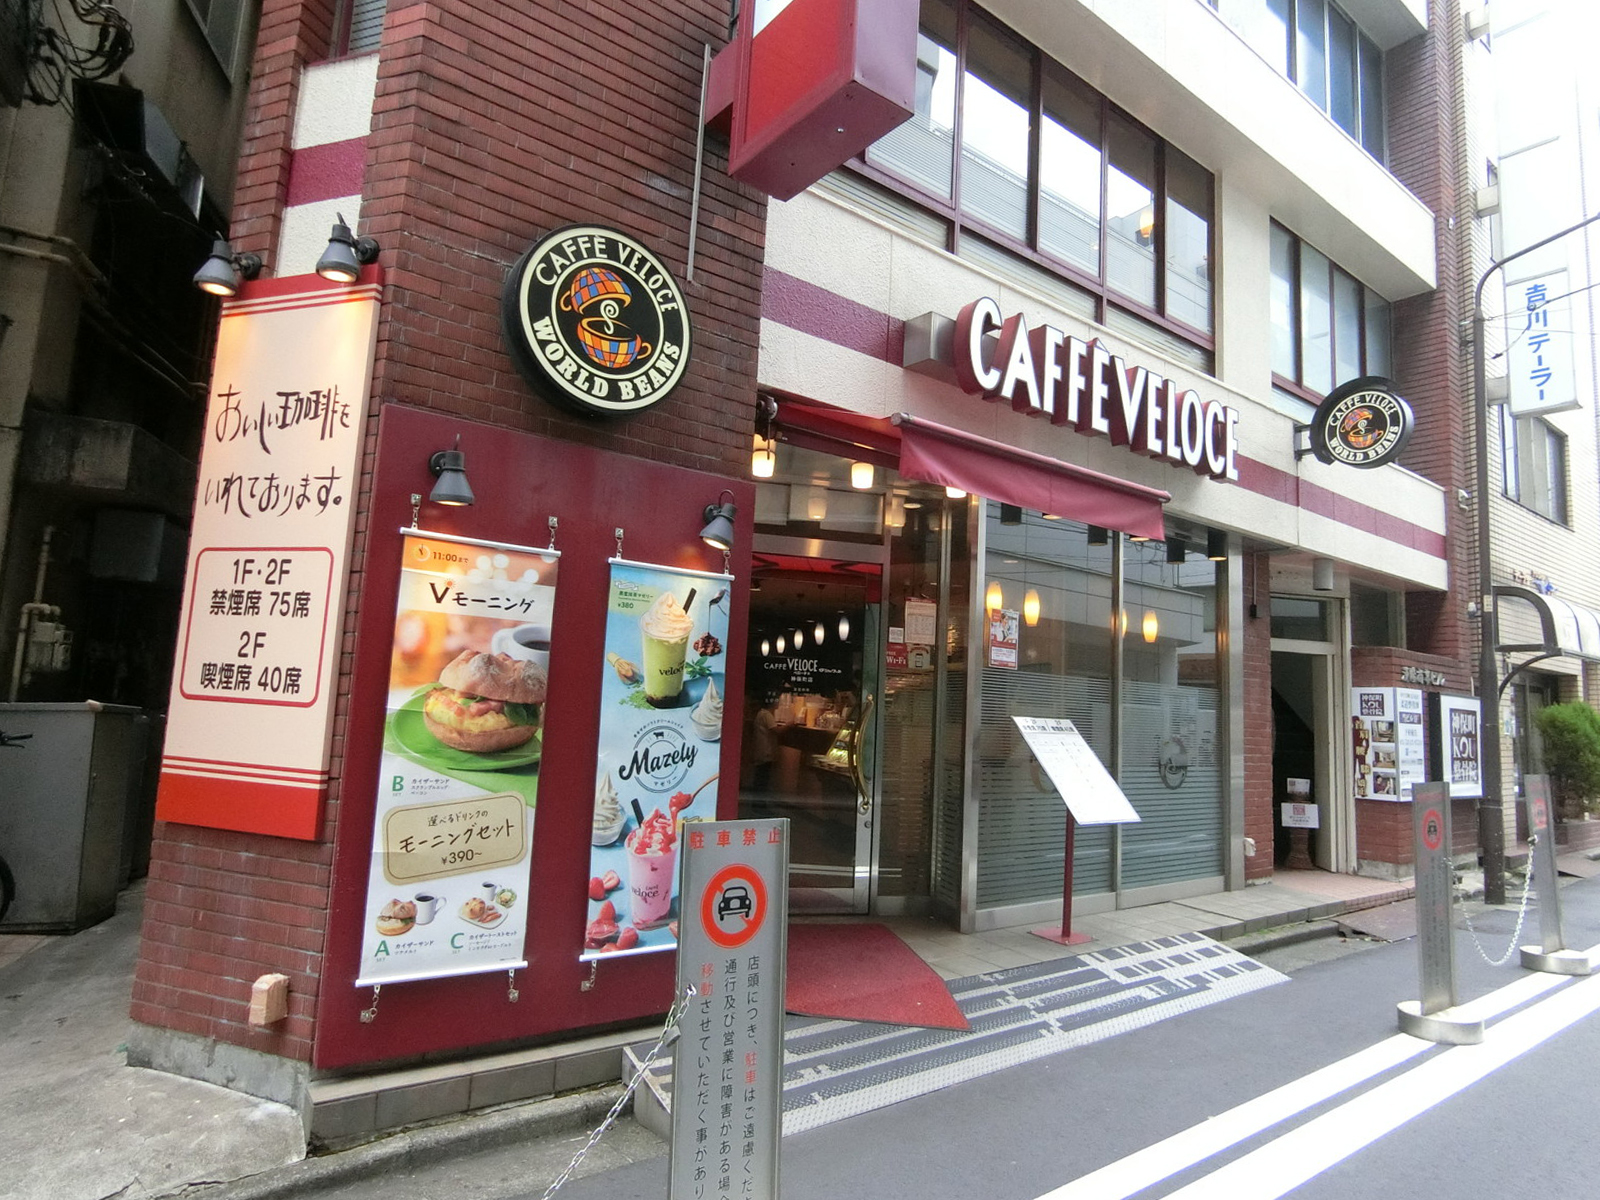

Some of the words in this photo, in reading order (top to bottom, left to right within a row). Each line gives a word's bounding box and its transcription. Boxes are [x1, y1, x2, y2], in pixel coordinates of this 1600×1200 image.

[535, 235, 608, 286] CAFFÈ
[618, 242, 679, 313] VELOCE
[532, 316, 609, 398] WORLD
[618, 341, 680, 401] BEANS
[1525, 284, 1552, 401] 吉川テーラー
[215, 383, 351, 455] おいしい珈琲を
[1111, 354, 1240, 482] VELOCE
[1365, 394, 1398, 415] VELOCE
[1329, 437, 1364, 461] WORLD
[1367, 425, 1400, 459] BEANS
[204, 466, 342, 518] いれております。
[432, 551, 469, 564] 11:00まで
[208, 590, 261, 617] 禁煙席
[268, 590, 311, 619] 75席
[237, 630, 267, 659] 2F
[199, 662, 251, 691] 喫煙席
[257, 665, 302, 695] 40席
[787, 658, 819, 672] VELOCE
[618, 742, 699, 781] Mazely
[391, 775, 405, 792] B
[427, 809, 489, 827] 選べるドリンクの
[399, 818, 515, 854] モーニングセット
[687, 826, 782, 850] 駐車禁止
[374, 940, 390, 957] A
[450, 932, 465, 949] C
[693, 962, 715, 1199] 移動させていただく事があり
[741, 955, 760, 1200] 店頭につき、駐車はご遠慮くだ
